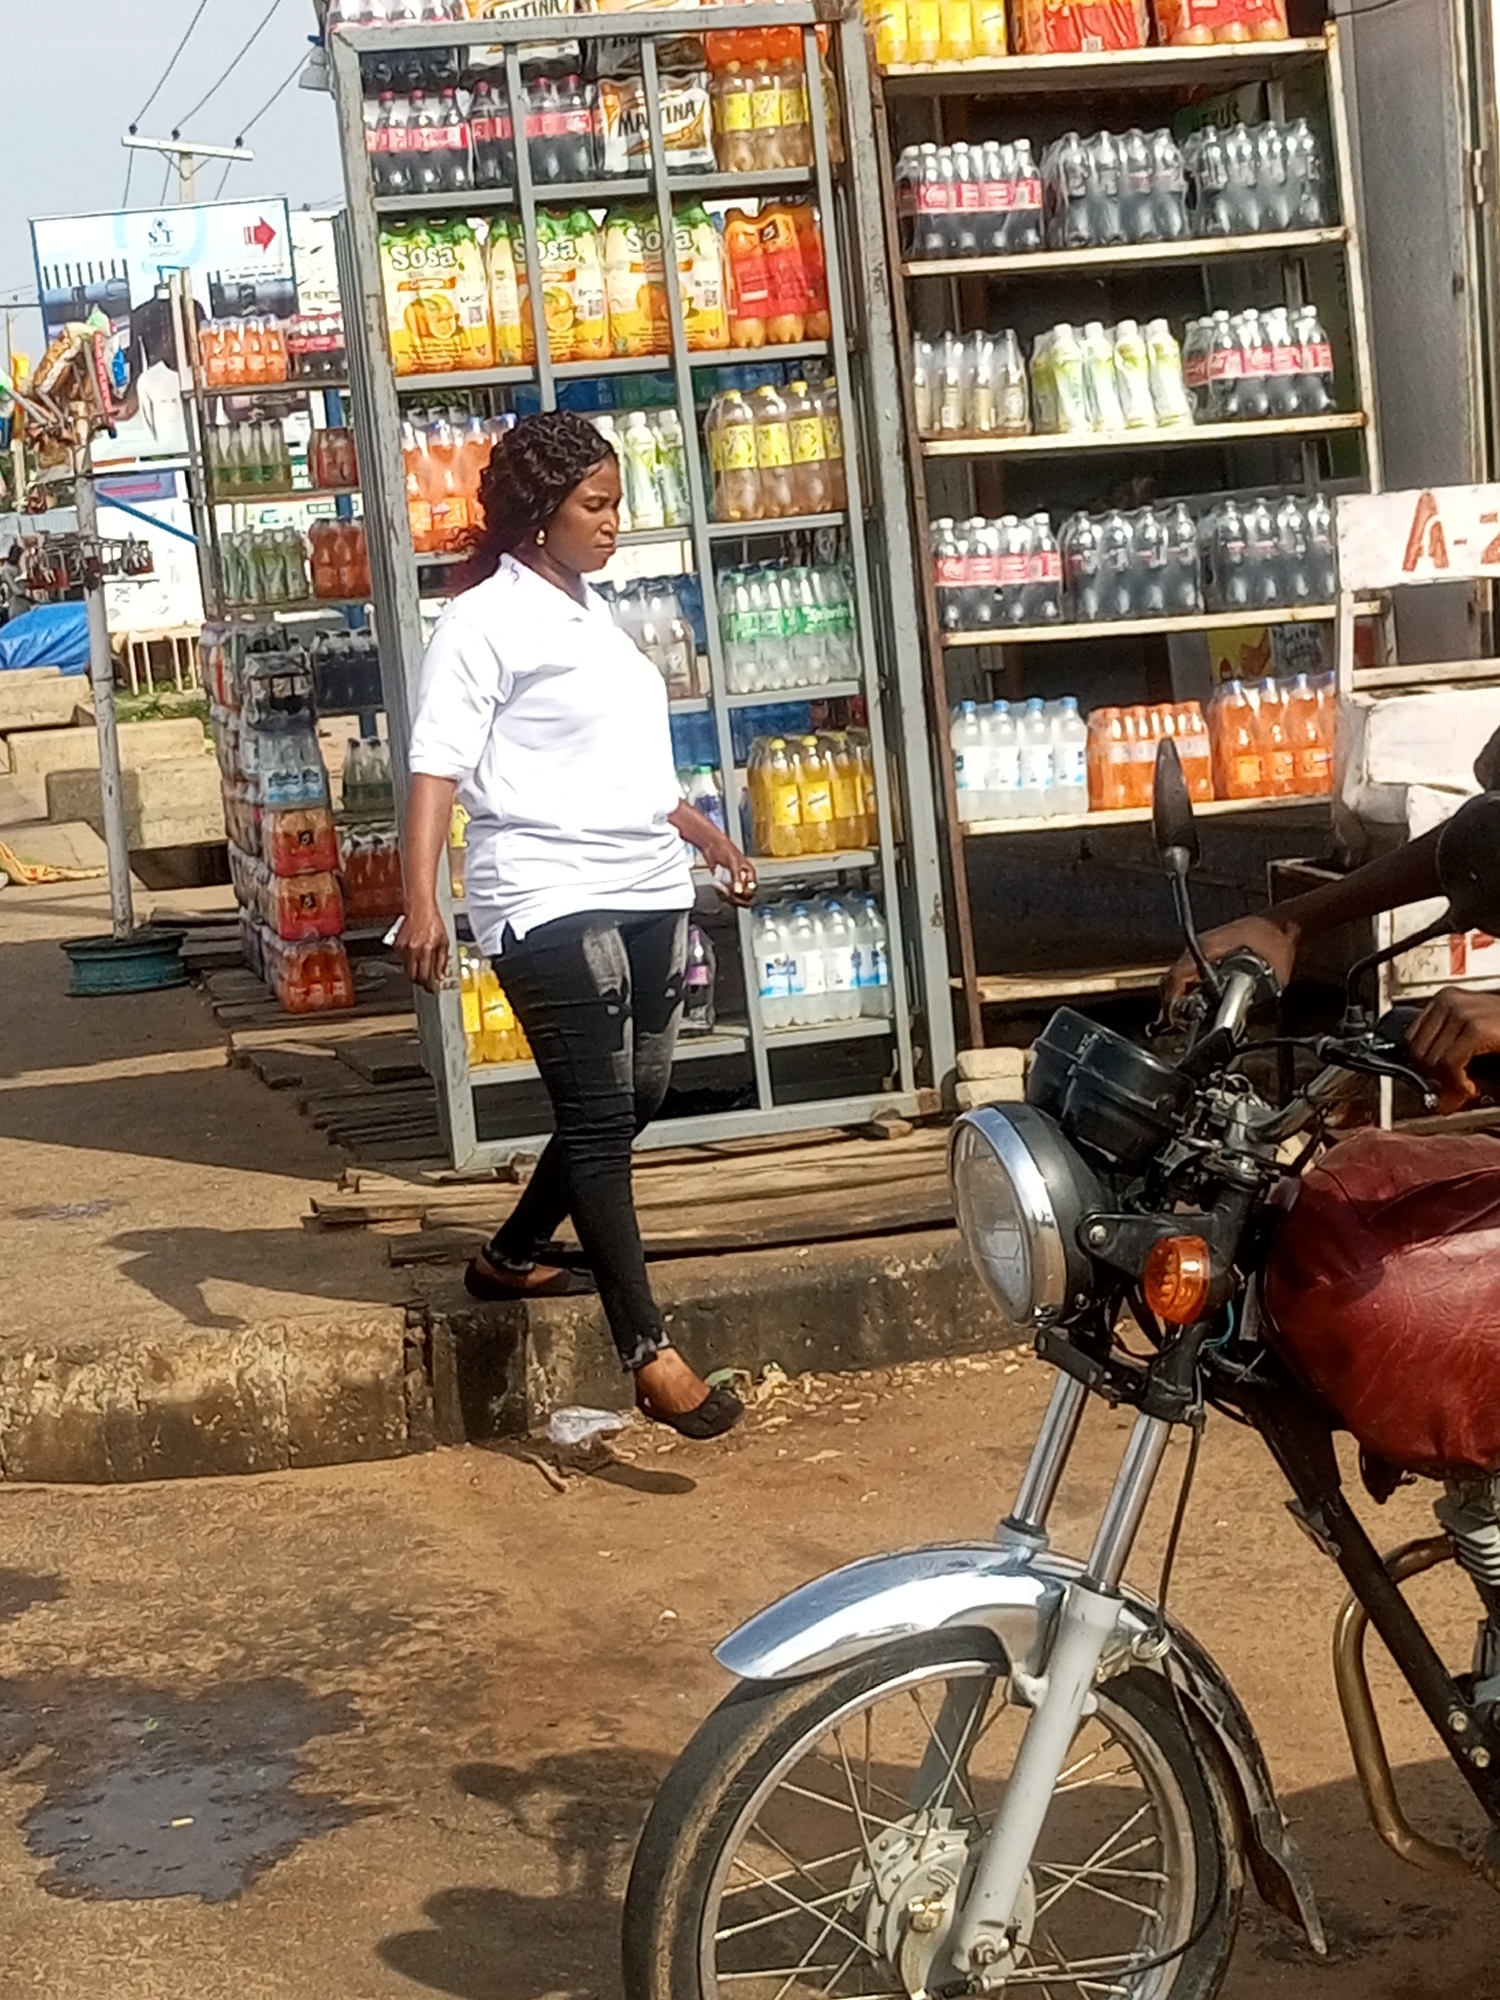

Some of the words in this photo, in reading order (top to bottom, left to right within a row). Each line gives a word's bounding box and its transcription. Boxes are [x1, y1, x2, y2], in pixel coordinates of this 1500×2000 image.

[618, 99, 697, 137] MAINA
[626, 226, 694, 253] Soa
[390, 244, 458, 271] Sosa
